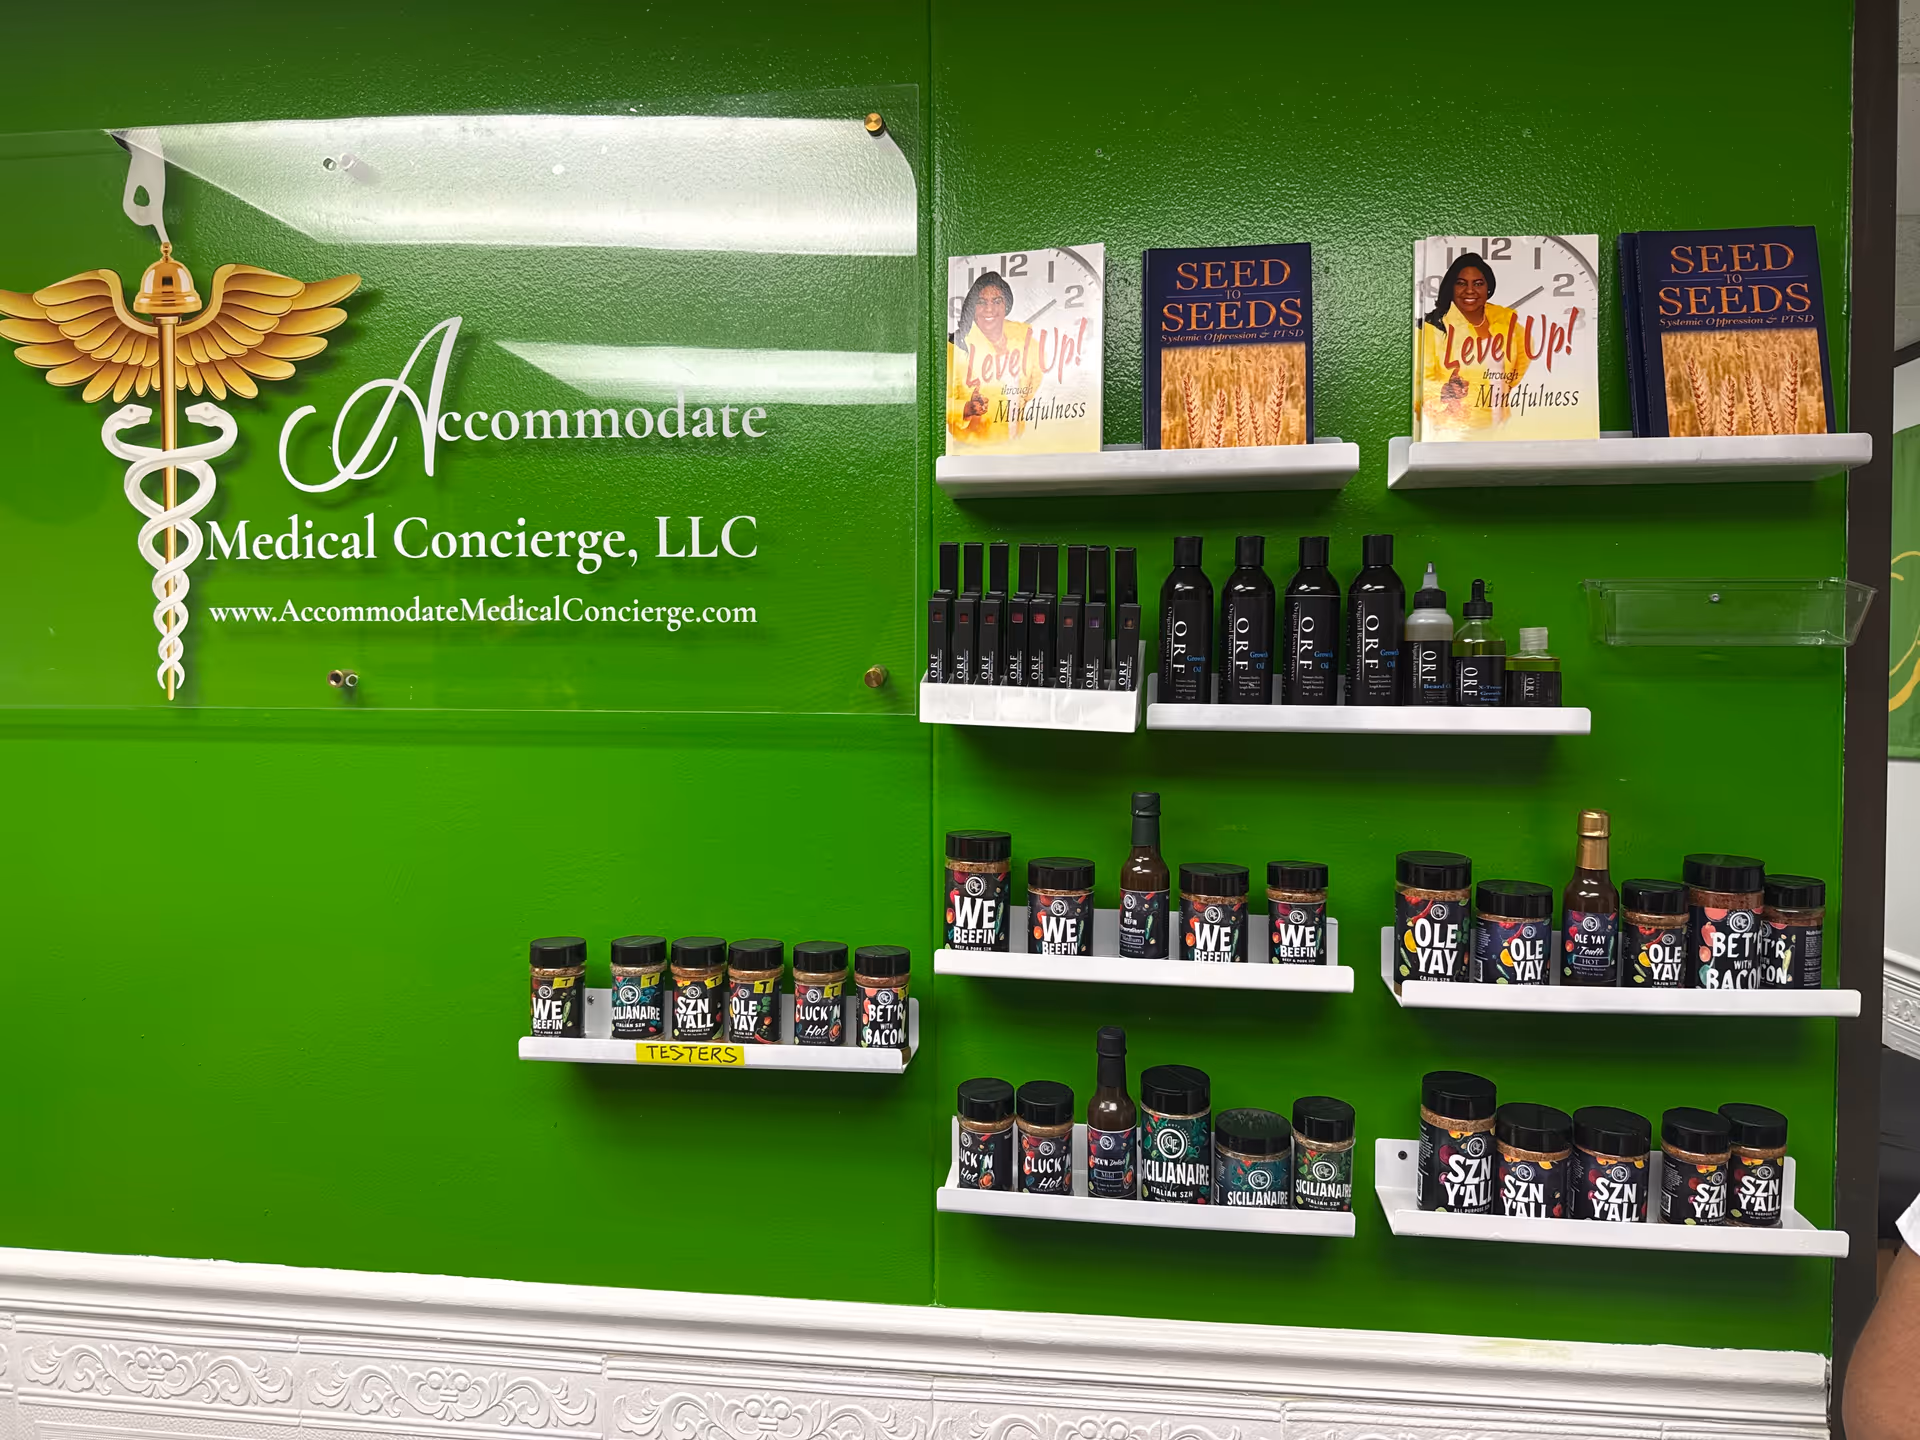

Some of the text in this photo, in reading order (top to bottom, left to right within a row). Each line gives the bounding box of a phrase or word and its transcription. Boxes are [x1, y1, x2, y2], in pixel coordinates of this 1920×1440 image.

[1481, 237, 1513, 261] 12
[1669, 242, 1796, 275] SEED
[1176, 258, 1292, 291] SEED
[1723, 273, 1742, 285] TO
[1225, 288, 1242, 301] TO
[1657, 282, 1812, 317] SEEDS
[1161, 297, 1304, 333] SEEDS
[1658, 317, 1703, 329] Systemic
[1705, 316, 1764, 328] Oppression
[1780, 313, 1815, 325] PTSD
[1160, 333, 1202, 344] Systemic
[1203, 330, 1258, 343] Oppression
[1273, 328, 1305, 339] PTSD
[1443, 310, 1517, 370] Level
[1524, 305, 1580, 373] Up!
[966, 316, 1089, 388] Level Up!
[1482, 368, 1519, 382] through
[1000, 383, 1034, 399] through
[1473, 383, 1580, 417] Mindfulness
[279, 316, 768, 494] Accommodate
[993, 399, 1087, 431] Mindfulness
[205, 513, 759, 575] Medical Concierge, LLC
[208, 596, 758, 632] www.AccommodateMedicalConcierge.com
[1173, 620, 1188, 674] ORF
[1235, 617, 1250, 671] ORF
[1299, 616, 1315, 670] ORF
[1365, 614, 1380, 669] ORF
[930, 653, 939, 679] ORF
[956, 654, 965, 680] ORF
[981, 655, 990, 681] ORF
[1009, 654, 1018, 681] ORF
[1031, 655, 1040, 681] ORF
[1059, 658, 1068, 684] ORF
[1085, 663, 1095, 689] ORF
[1118, 660, 1128, 687] ORF
[1422, 650, 1437, 682] ORF
[1463, 666, 1479, 697] ORF
[1526, 677, 1535, 697] ORF
[954, 895, 996, 930] WE
[953, 925, 996, 945] BEEFIN
[1042, 915, 1078, 944] WE
[1194, 922, 1232, 952] WE
[1279, 923, 1316, 948] WE
[1414, 917, 1458, 949] OLE
[1574, 933, 1606, 944] OLE YAY
[1042, 941, 1078, 956] BEEFIN
[1194, 948, 1232, 964] BEEFIN
[1280, 945, 1317, 958] BEEFIN
[1510, 938, 1544, 961] OLE
[1648, 943, 1682, 963] OLE
[1416, 947, 1458, 976] YAY
[1513, 959, 1544, 981] YAY
[1650, 963, 1682, 981] YAY
[1734, 959, 1752, 970] WITH
[562, 978, 571, 986] T
[646, 976, 655, 985] T
[711, 976, 719, 986] T
[759, 981, 770, 994] T
[829, 985, 838, 997] T
[901, 986, 908, 995] T
[532, 997, 562, 1020] WE
[676, 996, 709, 1015] SZN
[732, 996, 758, 1016] OLE
[795, 1004, 841, 1021] CLUCK'N
[868, 1004, 903, 1022] BET'R
[532, 1018, 563, 1030] BEEFIN
[676, 1013, 714, 1029] Y'ALL
[733, 1014, 759, 1032] YAY
[805, 1024, 829, 1037] Hot
[865, 1028, 905, 1046] BACON
[646, 1045, 737, 1063] TESTERS
[960, 1148, 993, 1169] UCK'N
[1024, 1154, 1071, 1174] CLUCK'N
[1446, 1154, 1492, 1184] SZN
[961, 1167, 979, 1183] Hot
[1038, 1176, 1062, 1189] Hot
[1151, 1185, 1194, 1198] ITALIAN SZN
[1295, 1178, 1352, 1199] SICILIANAIRE
[1444, 1179, 1492, 1207] Y'ALL
[1503, 1174, 1544, 1203] SZN
[1593, 1177, 1637, 1204] SZN
[1694, 1183, 1727, 1203] SZN
[1740, 1175, 1779, 1197] SZN
[1227, 1190, 1288, 1207] SICILIANAIRE
[1305, 1197, 1328, 1206] ITALIAN
[1737, 1192, 1781, 1212] Y'ALL
[1591, 1197, 1640, 1222] Y'ALL
